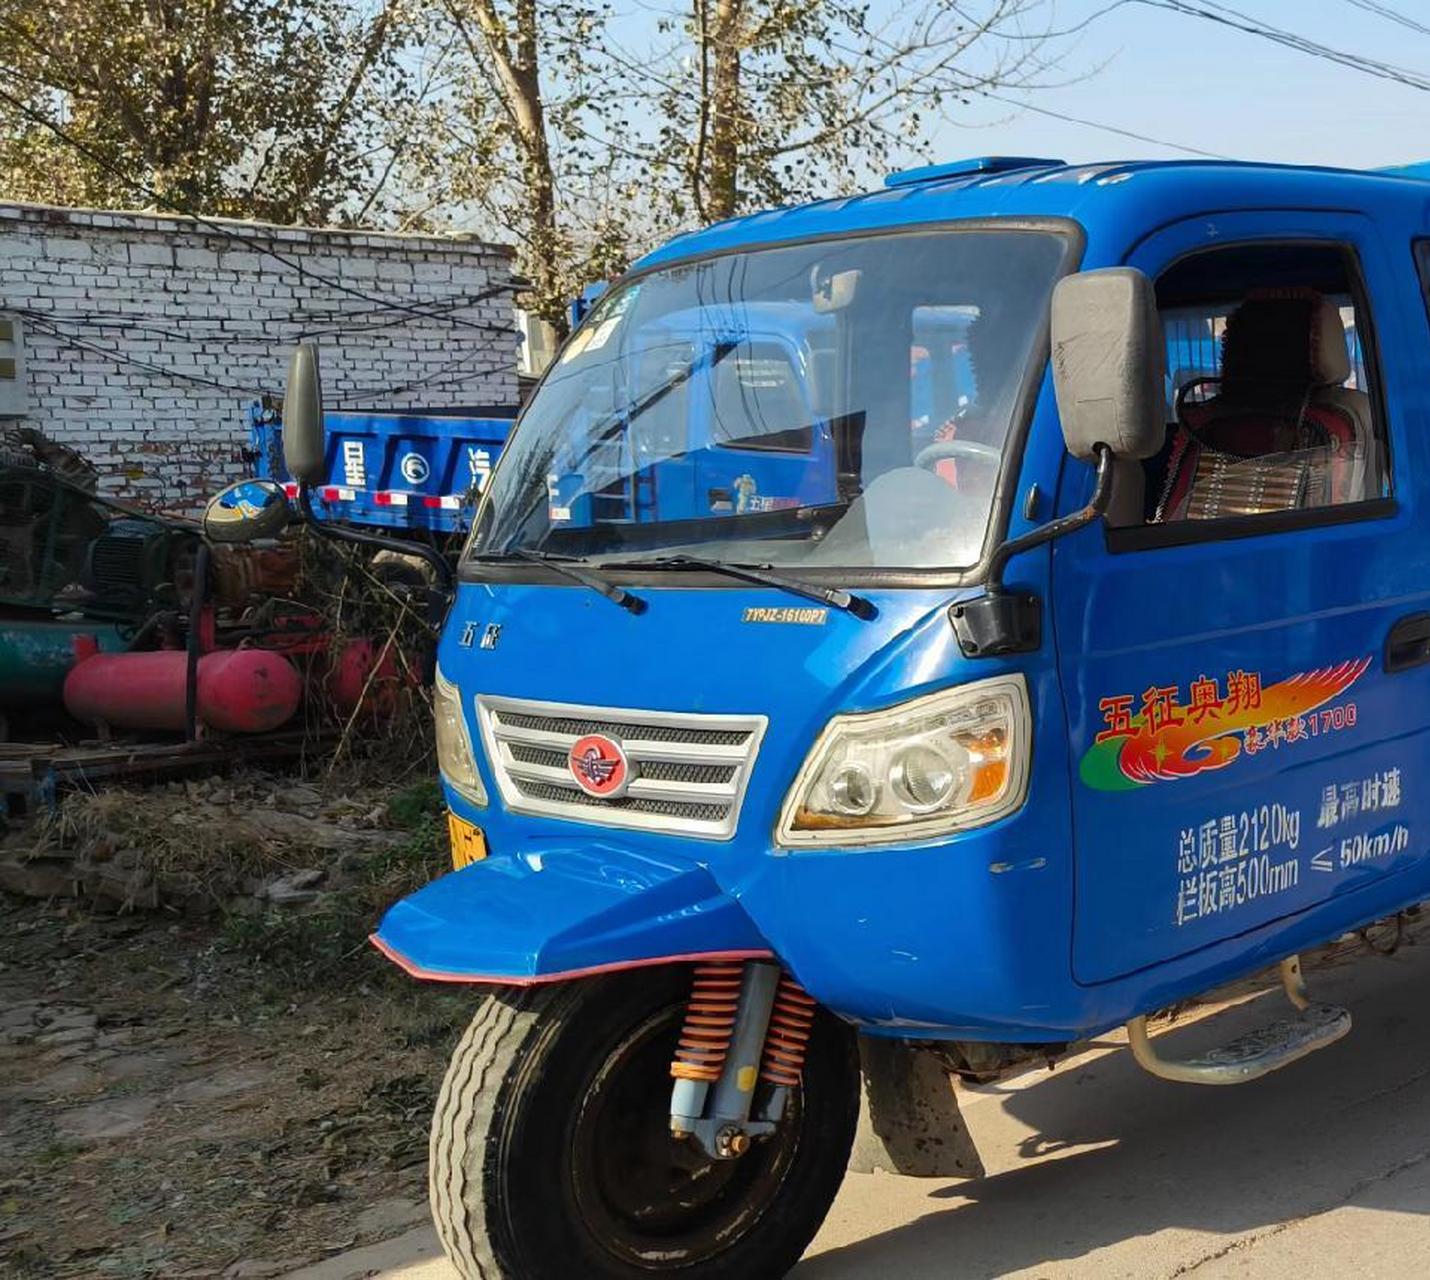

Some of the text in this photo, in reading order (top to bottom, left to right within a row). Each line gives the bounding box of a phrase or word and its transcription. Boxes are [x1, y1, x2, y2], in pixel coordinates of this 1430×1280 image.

[1096, 669, 1262, 744] 五征奥翔
[1317, 767, 1402, 829] 最高时速
[1177, 802, 1301, 874] 总质量2120kg
[1176, 854, 1299, 926] 栏板高500mm
